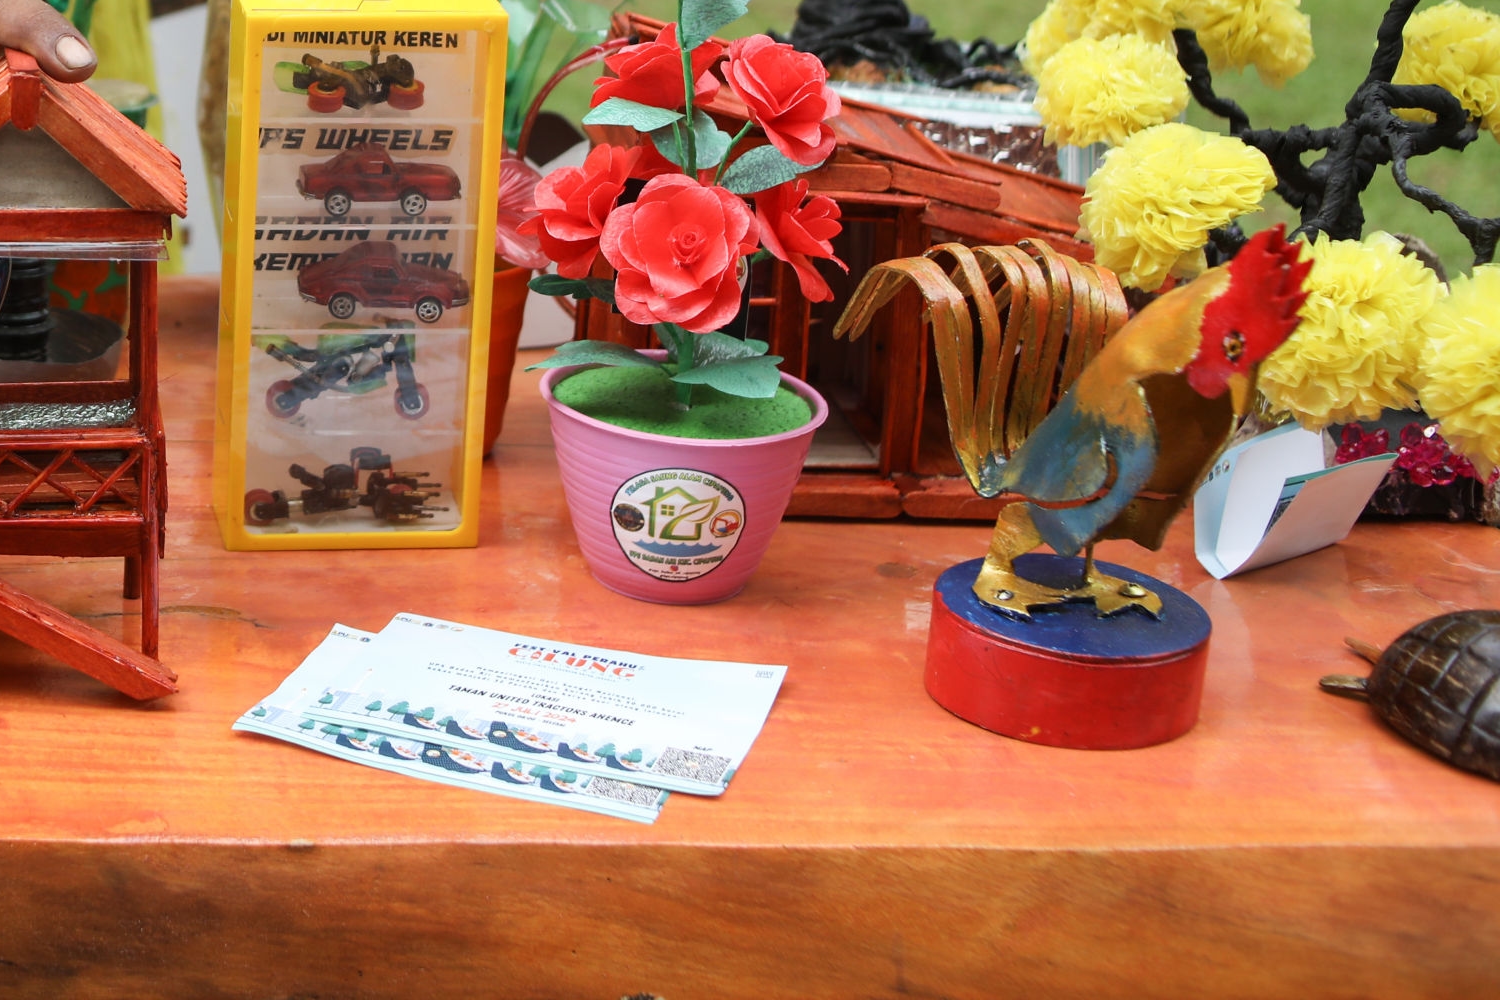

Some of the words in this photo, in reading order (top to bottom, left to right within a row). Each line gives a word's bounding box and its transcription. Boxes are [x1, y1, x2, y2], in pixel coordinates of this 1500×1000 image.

[263, 31, 285, 43] DI
[293, 31, 387, 46] MINIATUR
[393, 30, 459, 49] KEREN
[259, 127, 306, 150] PS
[315, 128, 454, 151] WHEELS
[386, 216, 453, 241] AIR
[449, 684, 488, 696] TAMAN
[489, 692, 530, 705] UNITED
[532, 700, 588, 716] TRACTORS
[531, 693, 560, 702] LOKASI
